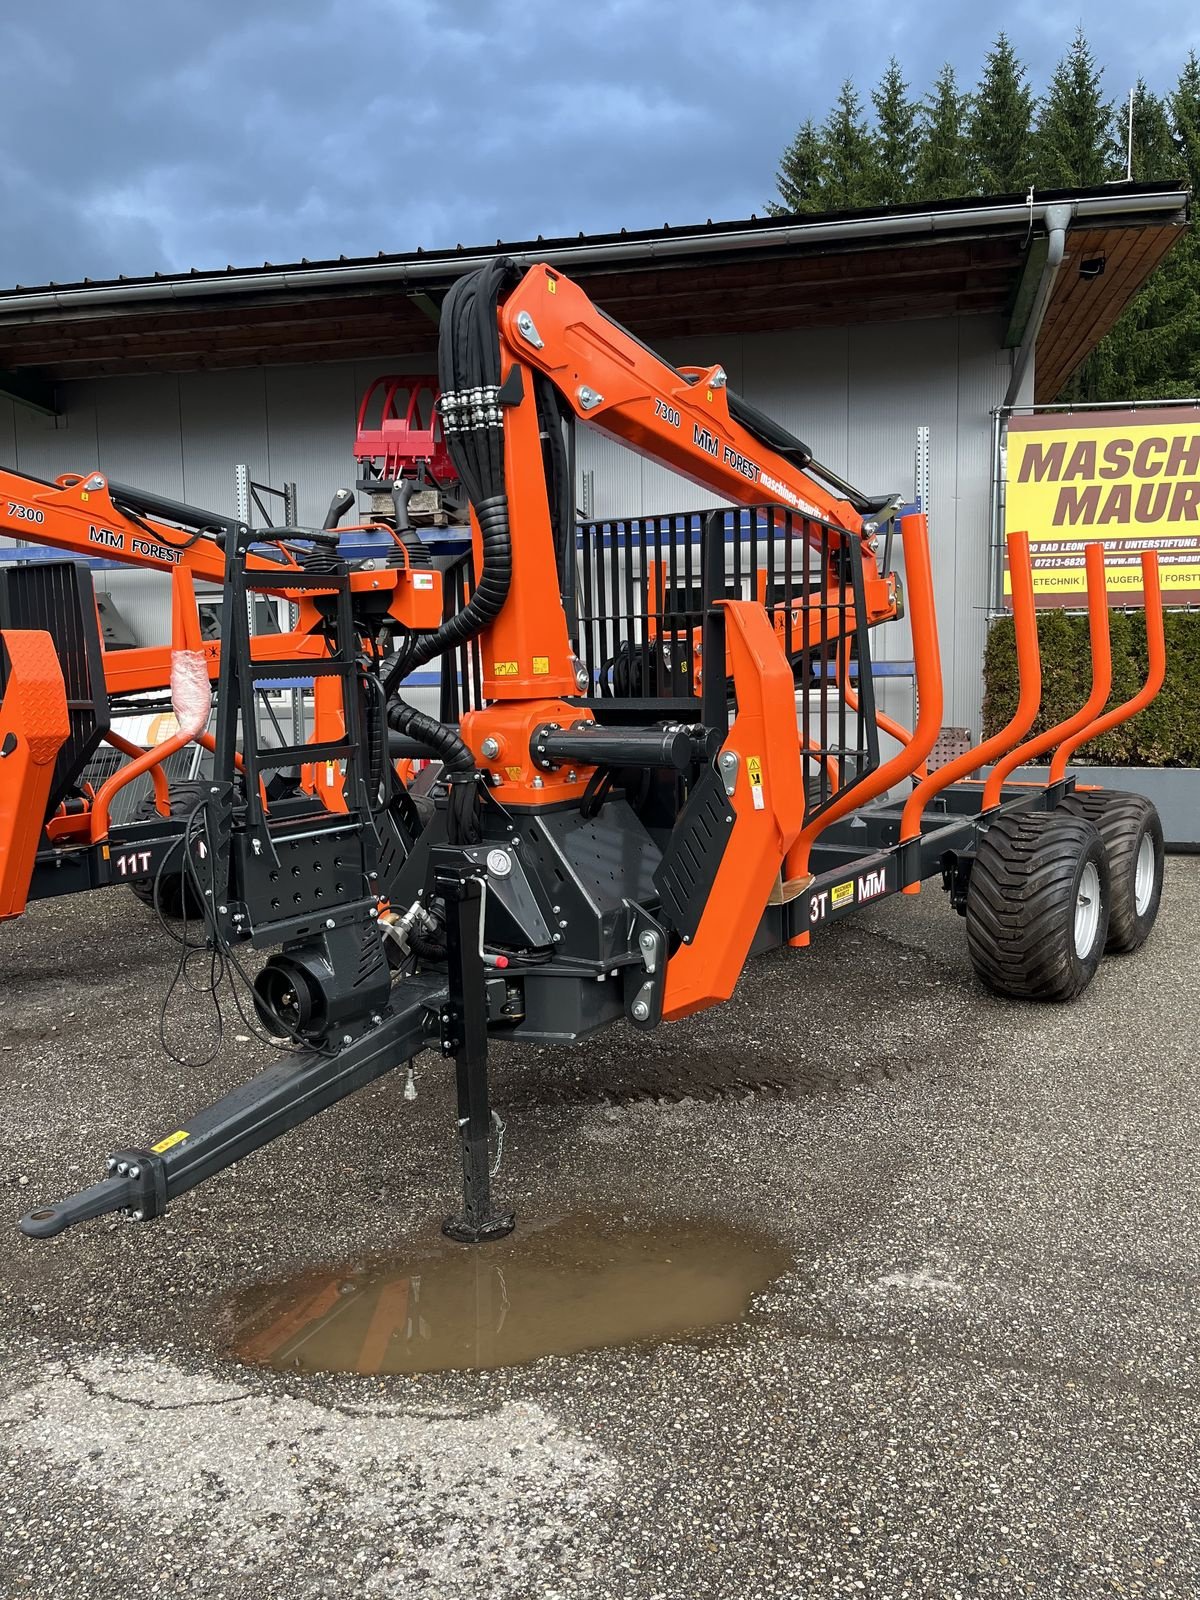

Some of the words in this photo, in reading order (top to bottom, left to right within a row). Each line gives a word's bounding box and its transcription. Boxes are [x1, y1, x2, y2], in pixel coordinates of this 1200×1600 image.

[655, 398, 681, 427] 7300
[693, 423, 719, 458] MTM
[723, 446, 761, 483] FOREST
[1017, 436, 1200, 483] MASCH
[8, 503, 44, 523] 7300
[1052, 481, 1200, 526] MAUR
[89, 525, 124, 549] MTM
[131, 539, 183, 564] FOREST
[1040, 543, 1058, 552] BAD
[1060, 541, 1117, 551] LEONEN
[1033, 577, 1080, 586] ETECHNIK
[117, 851, 152, 876] 11T
[858, 867, 886, 903] MTM
